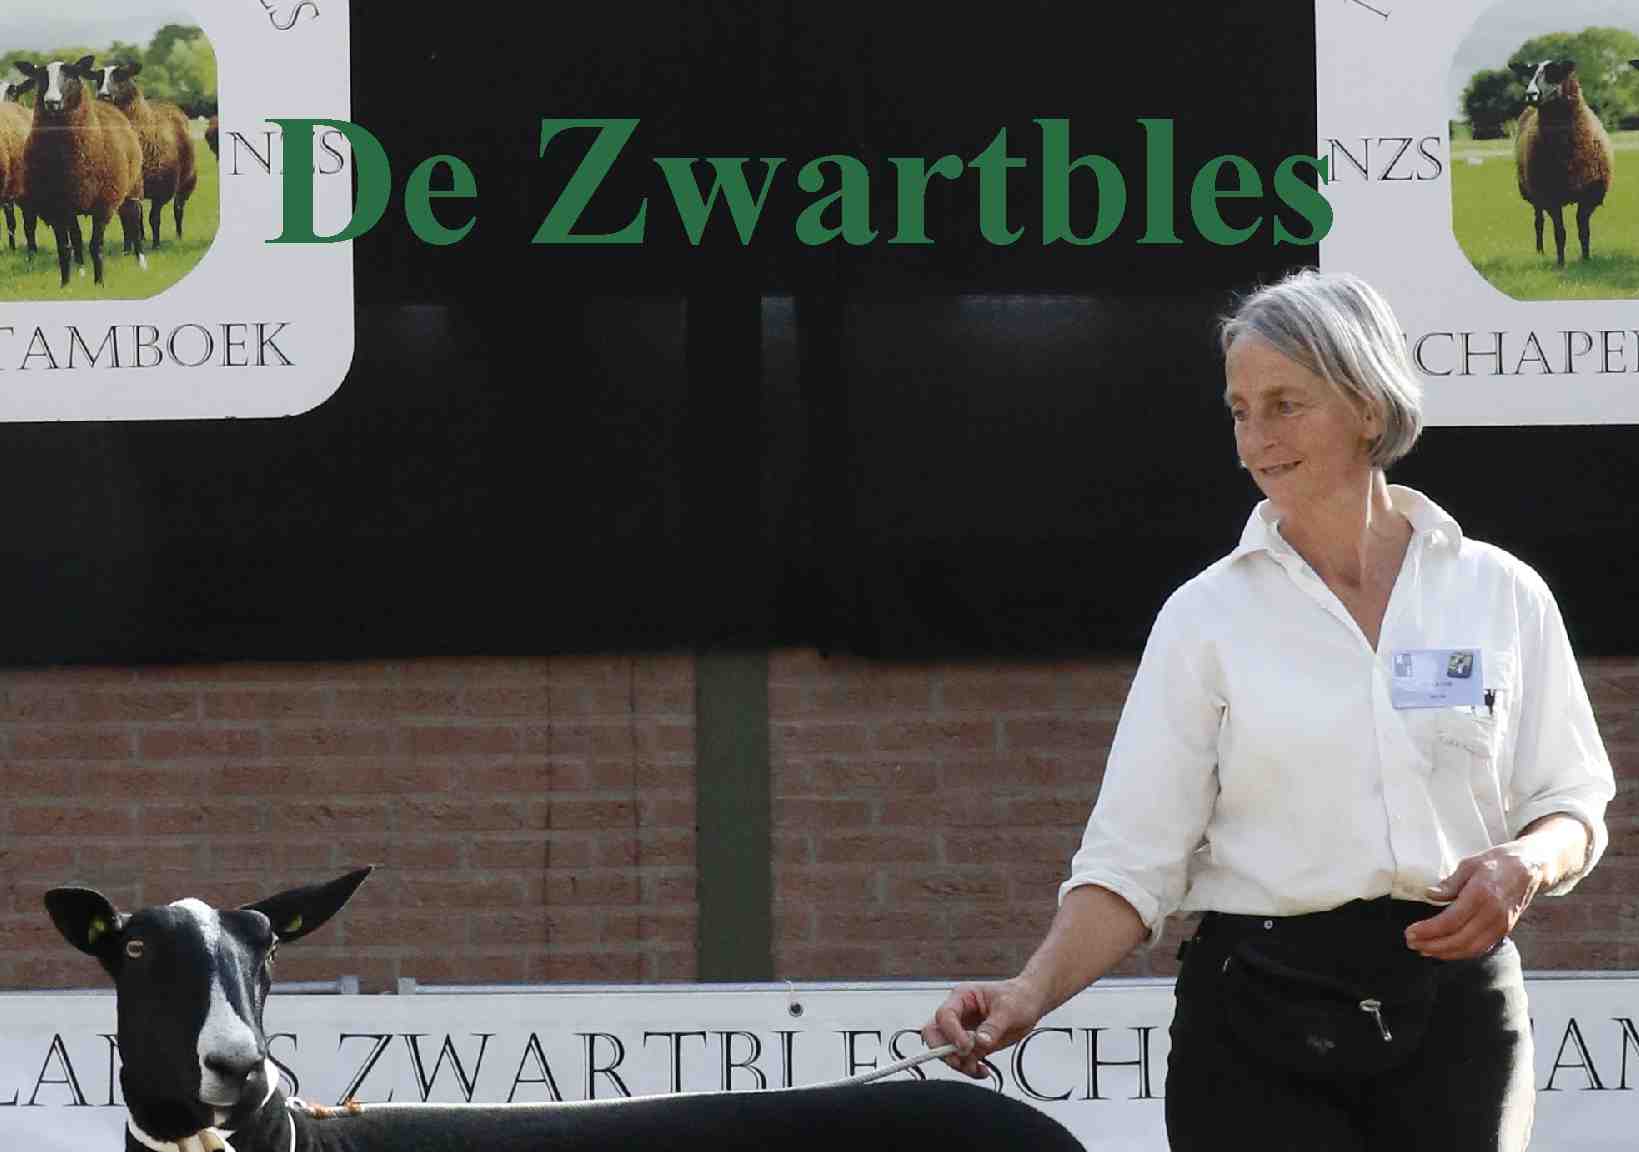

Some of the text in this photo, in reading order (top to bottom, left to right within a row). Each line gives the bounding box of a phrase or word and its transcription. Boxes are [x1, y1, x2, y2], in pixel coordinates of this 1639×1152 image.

[224, 130, 345, 176] NS
[1321, 136, 1443, 182] NZS
[1401, 329, 1639, 376] CHAPE
